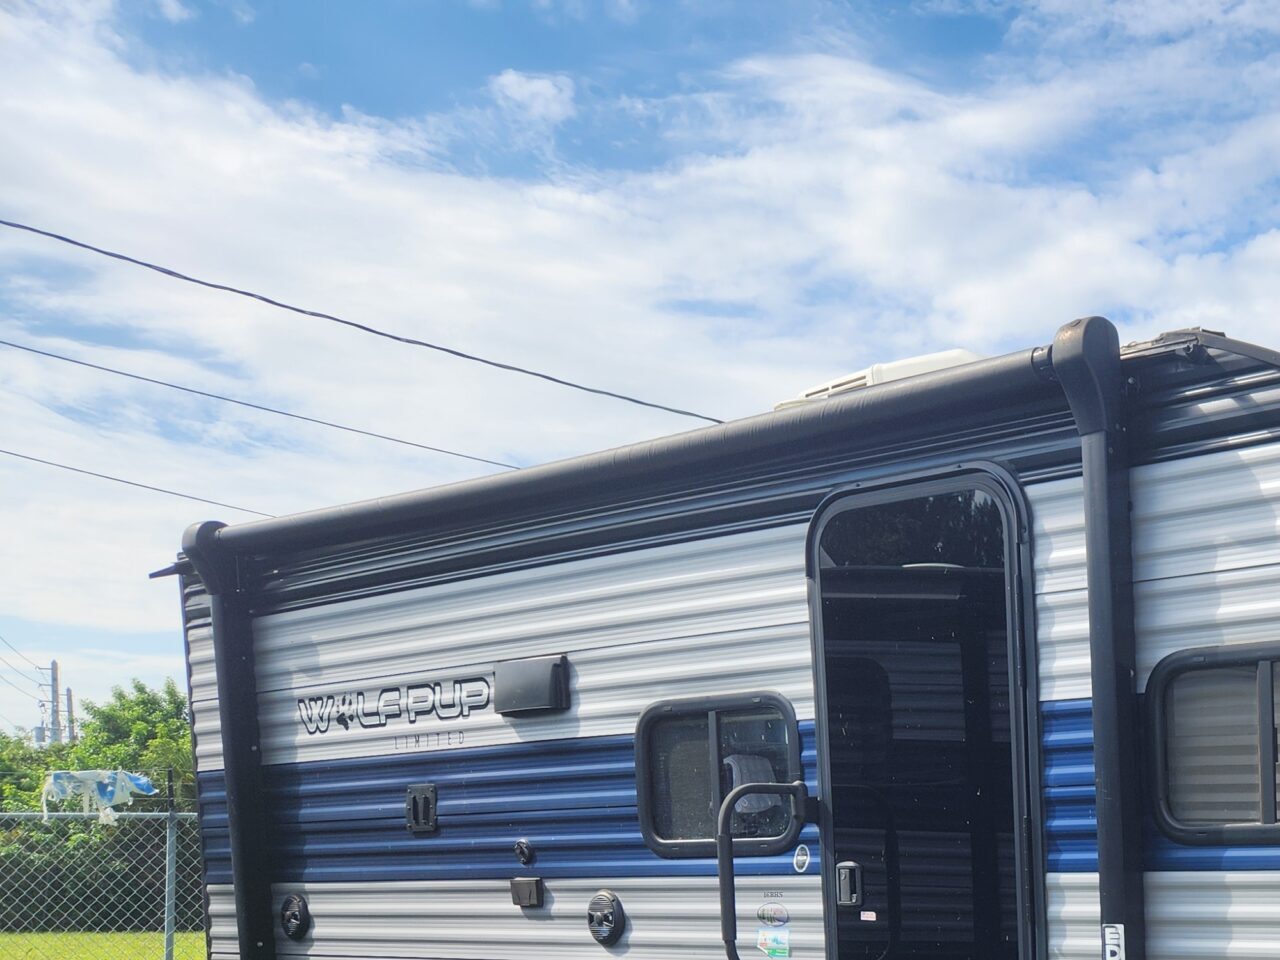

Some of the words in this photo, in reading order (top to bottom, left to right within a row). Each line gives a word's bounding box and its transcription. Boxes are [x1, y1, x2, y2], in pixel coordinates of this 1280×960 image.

[298, 686, 401, 735] WLF
[406, 676, 490, 724] PUP
[394, 731, 465, 750] LIMITED
